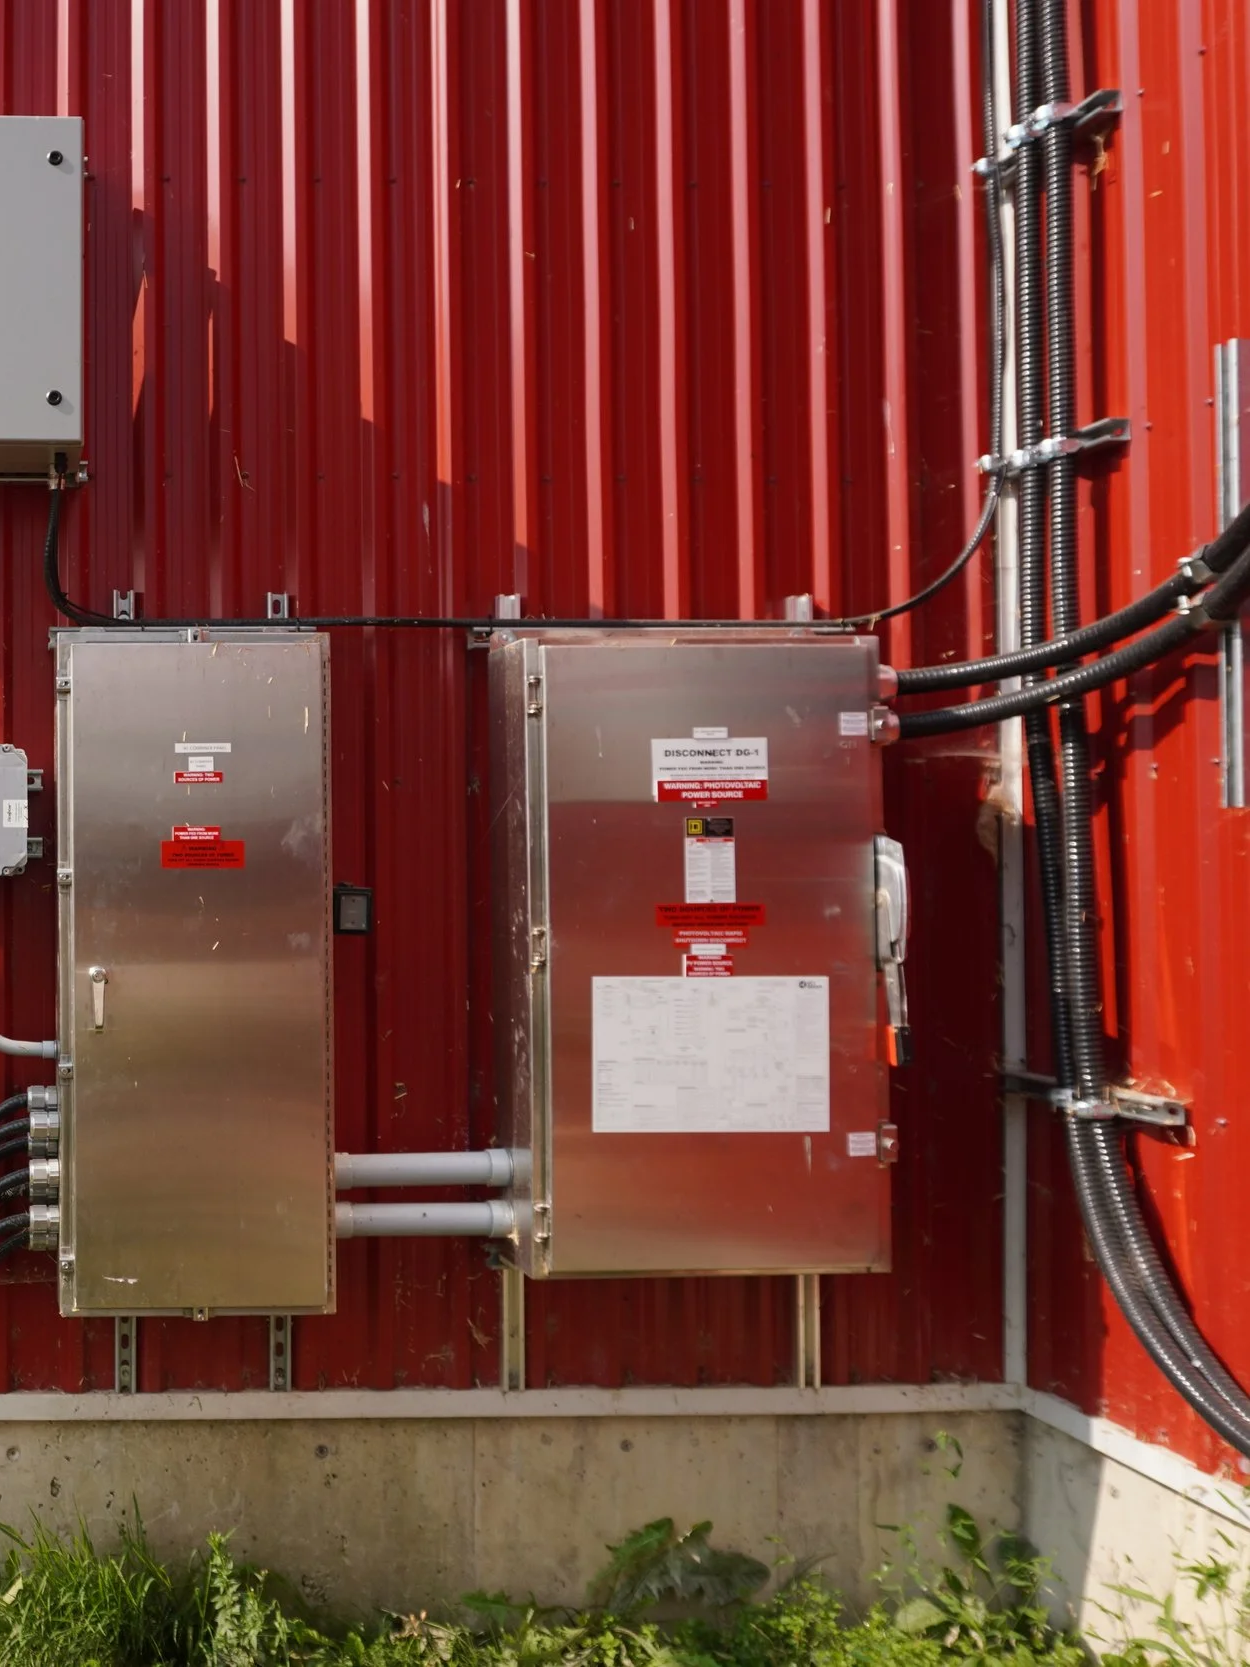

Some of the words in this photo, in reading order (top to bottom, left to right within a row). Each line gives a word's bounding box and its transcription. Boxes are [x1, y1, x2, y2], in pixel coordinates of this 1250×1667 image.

[664, 749, 732, 757] DISCONNECT
[663, 782, 703, 790] WARNING:
[704, 781, 761, 789] PHOTOVOLTAIC
[681, 791, 710, 799] POWER
[711, 791, 744, 799] SOURCE
